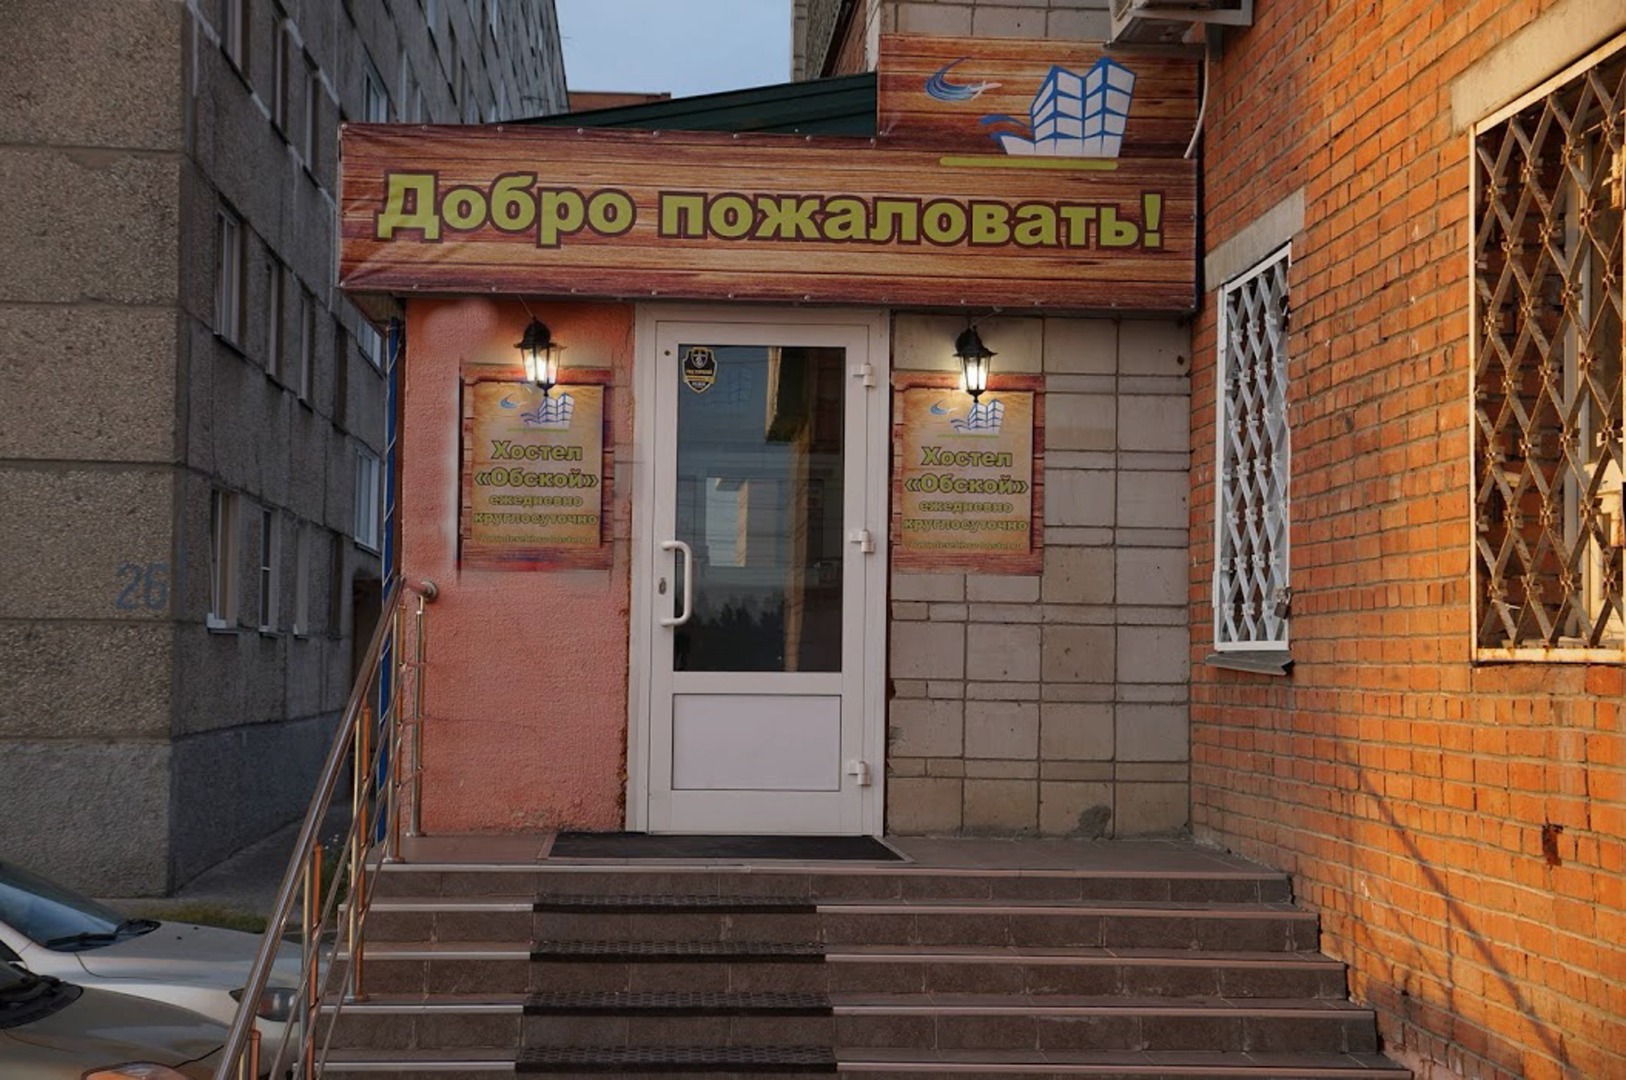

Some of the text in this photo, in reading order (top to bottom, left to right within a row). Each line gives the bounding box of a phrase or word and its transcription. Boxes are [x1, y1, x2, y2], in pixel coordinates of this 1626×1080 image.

[375, 170, 1163, 249] Добро пожаловать!
[491, 440, 583, 461] Хостел
[921, 446, 1013, 467] Хостел
[474, 467, 599, 488] «Обской»
[904, 473, 1029, 494] «Обской»
[115, 562, 169, 609] 26
